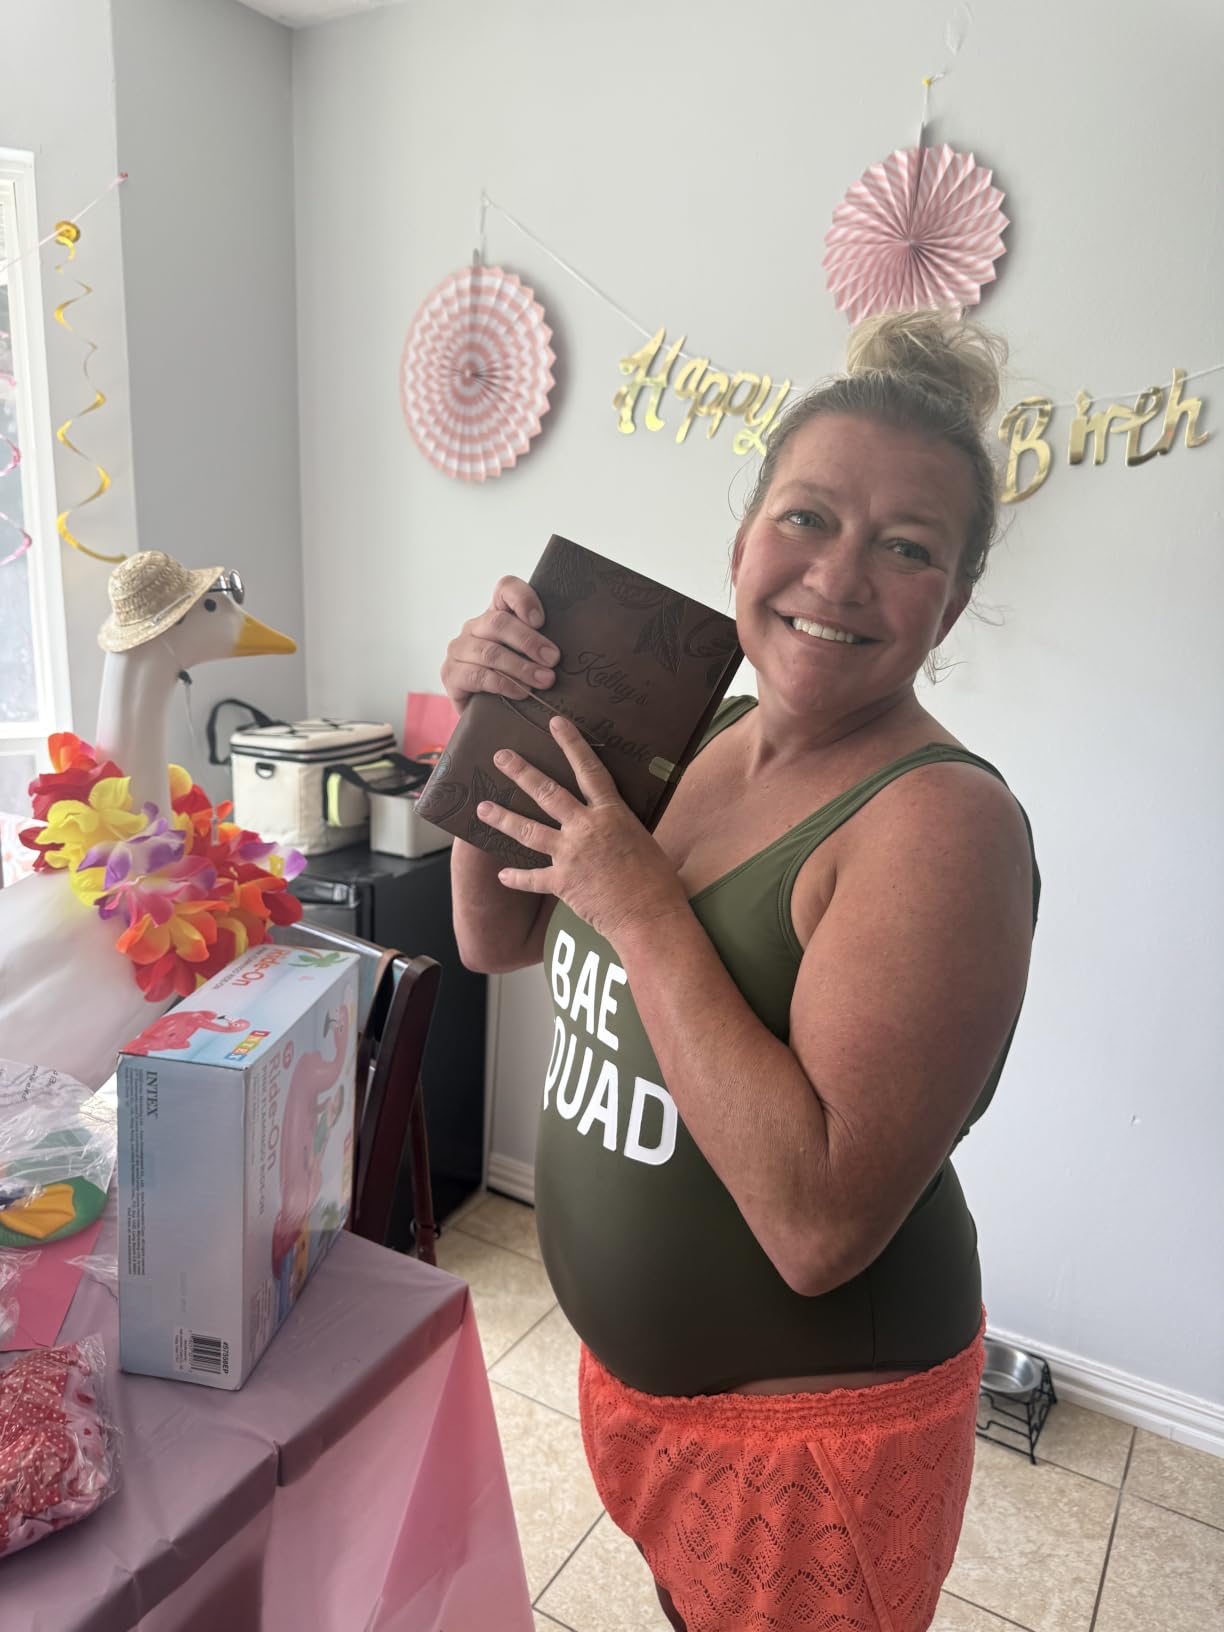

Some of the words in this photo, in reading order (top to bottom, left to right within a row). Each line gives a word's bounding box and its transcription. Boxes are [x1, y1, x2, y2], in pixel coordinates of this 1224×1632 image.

[613, 327, 790, 457] Happy
[551, 929, 628, 1051] BAE
[146, 1071, 158, 1117] INTEX
